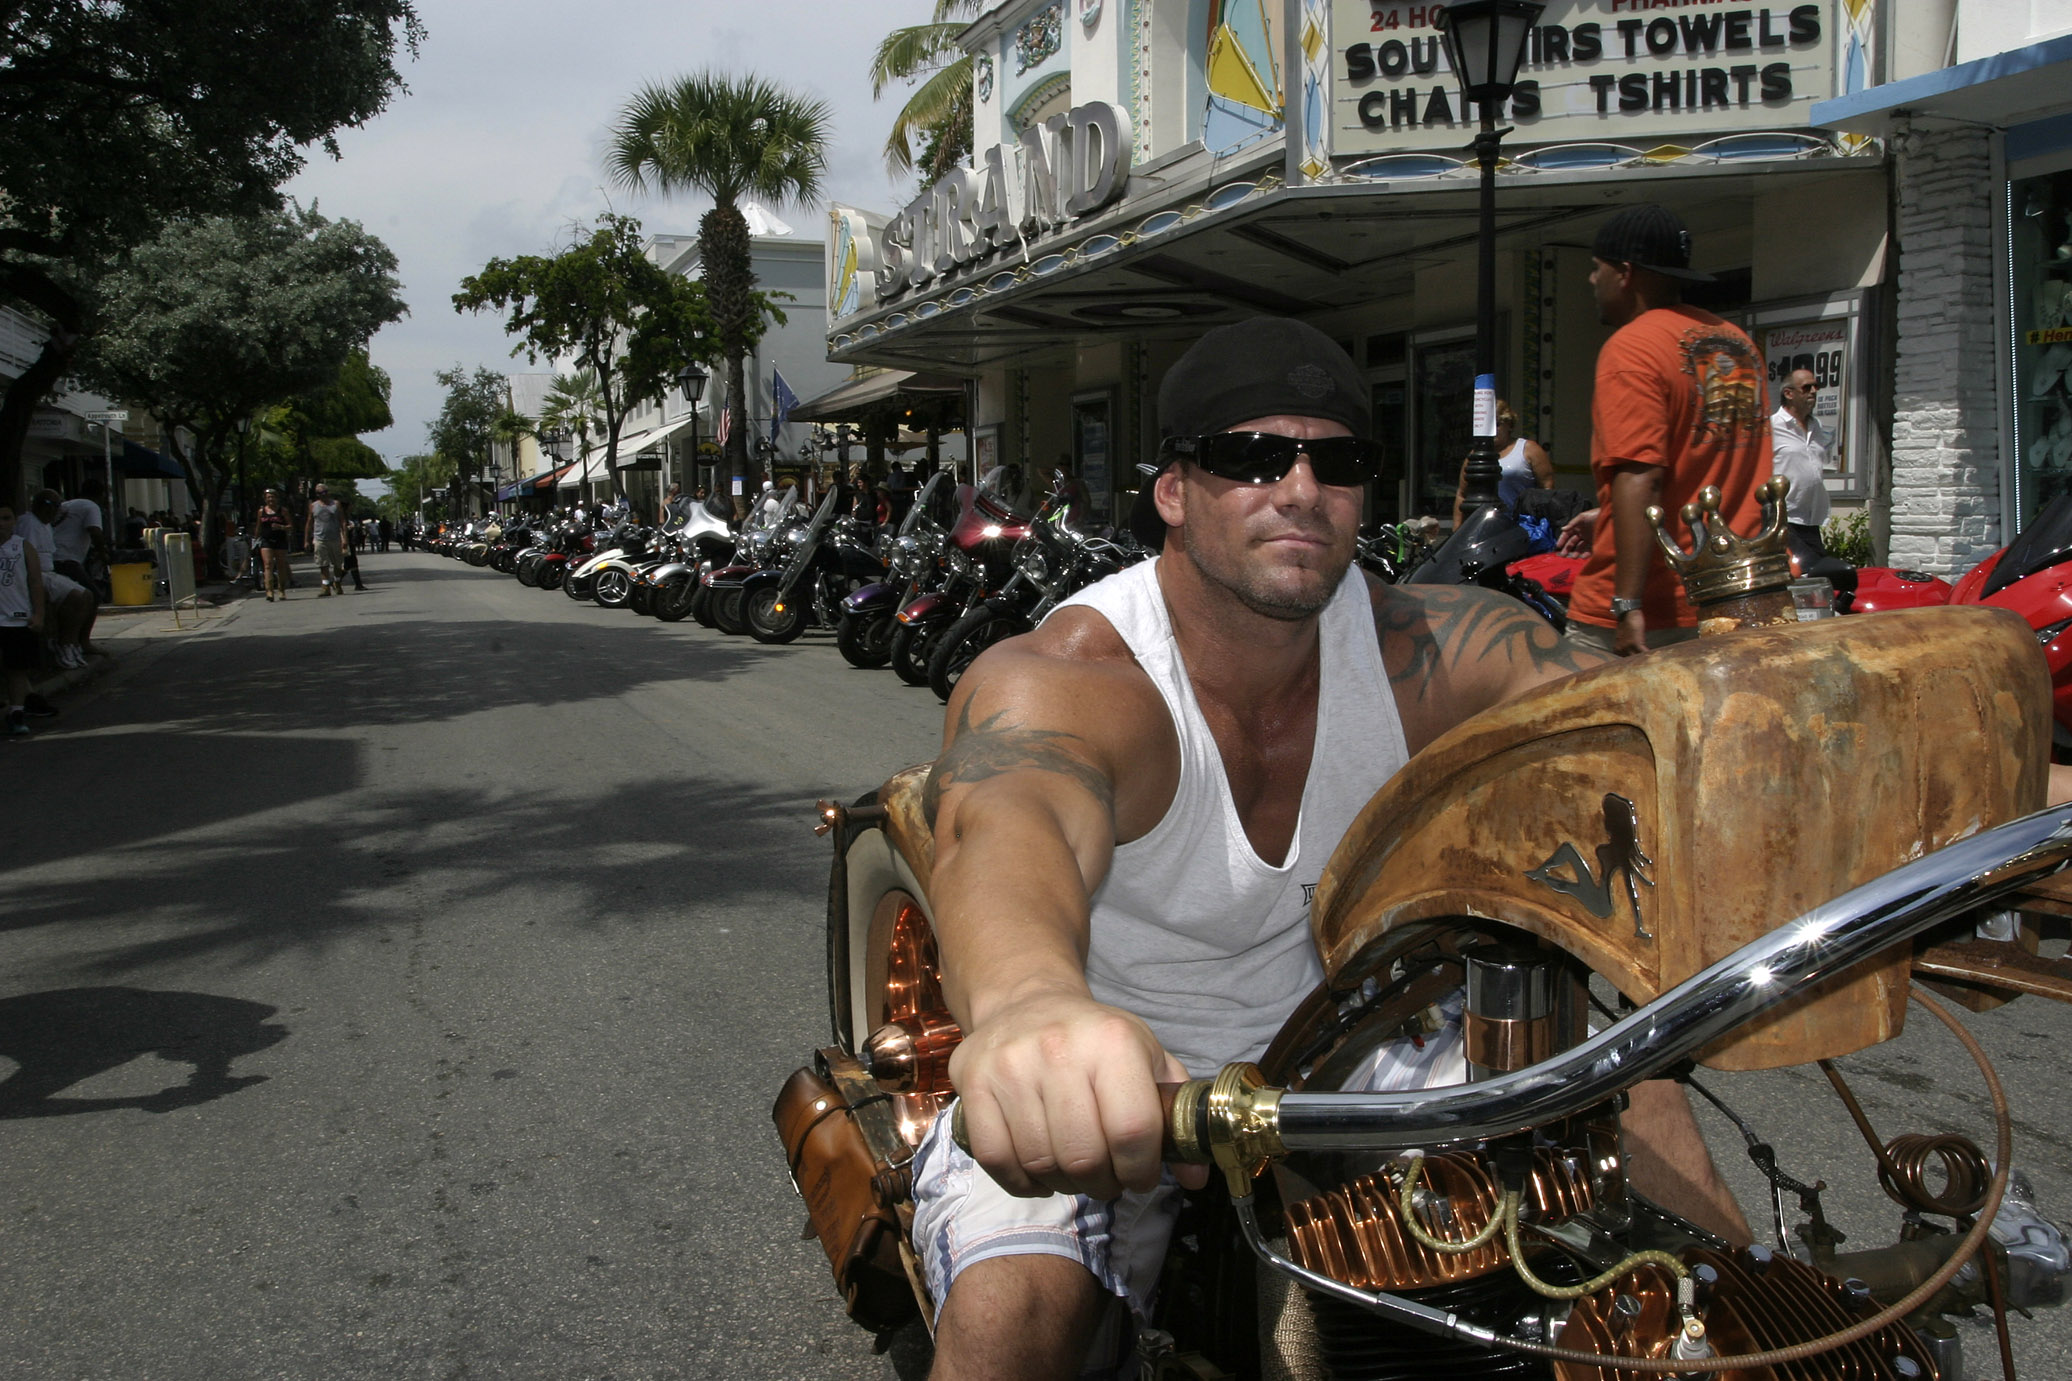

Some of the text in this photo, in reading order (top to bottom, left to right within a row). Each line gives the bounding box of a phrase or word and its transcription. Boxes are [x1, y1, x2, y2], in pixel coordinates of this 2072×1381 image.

[1346, 5, 1821, 80] SOUIRS TOWELS
[1370, 10, 1399, 32] 24
[1589, 62, 1792, 112] TSHIRTS
[876, 101, 1132, 297] STRAND
[1770, 330, 1844, 349] Walgreens
